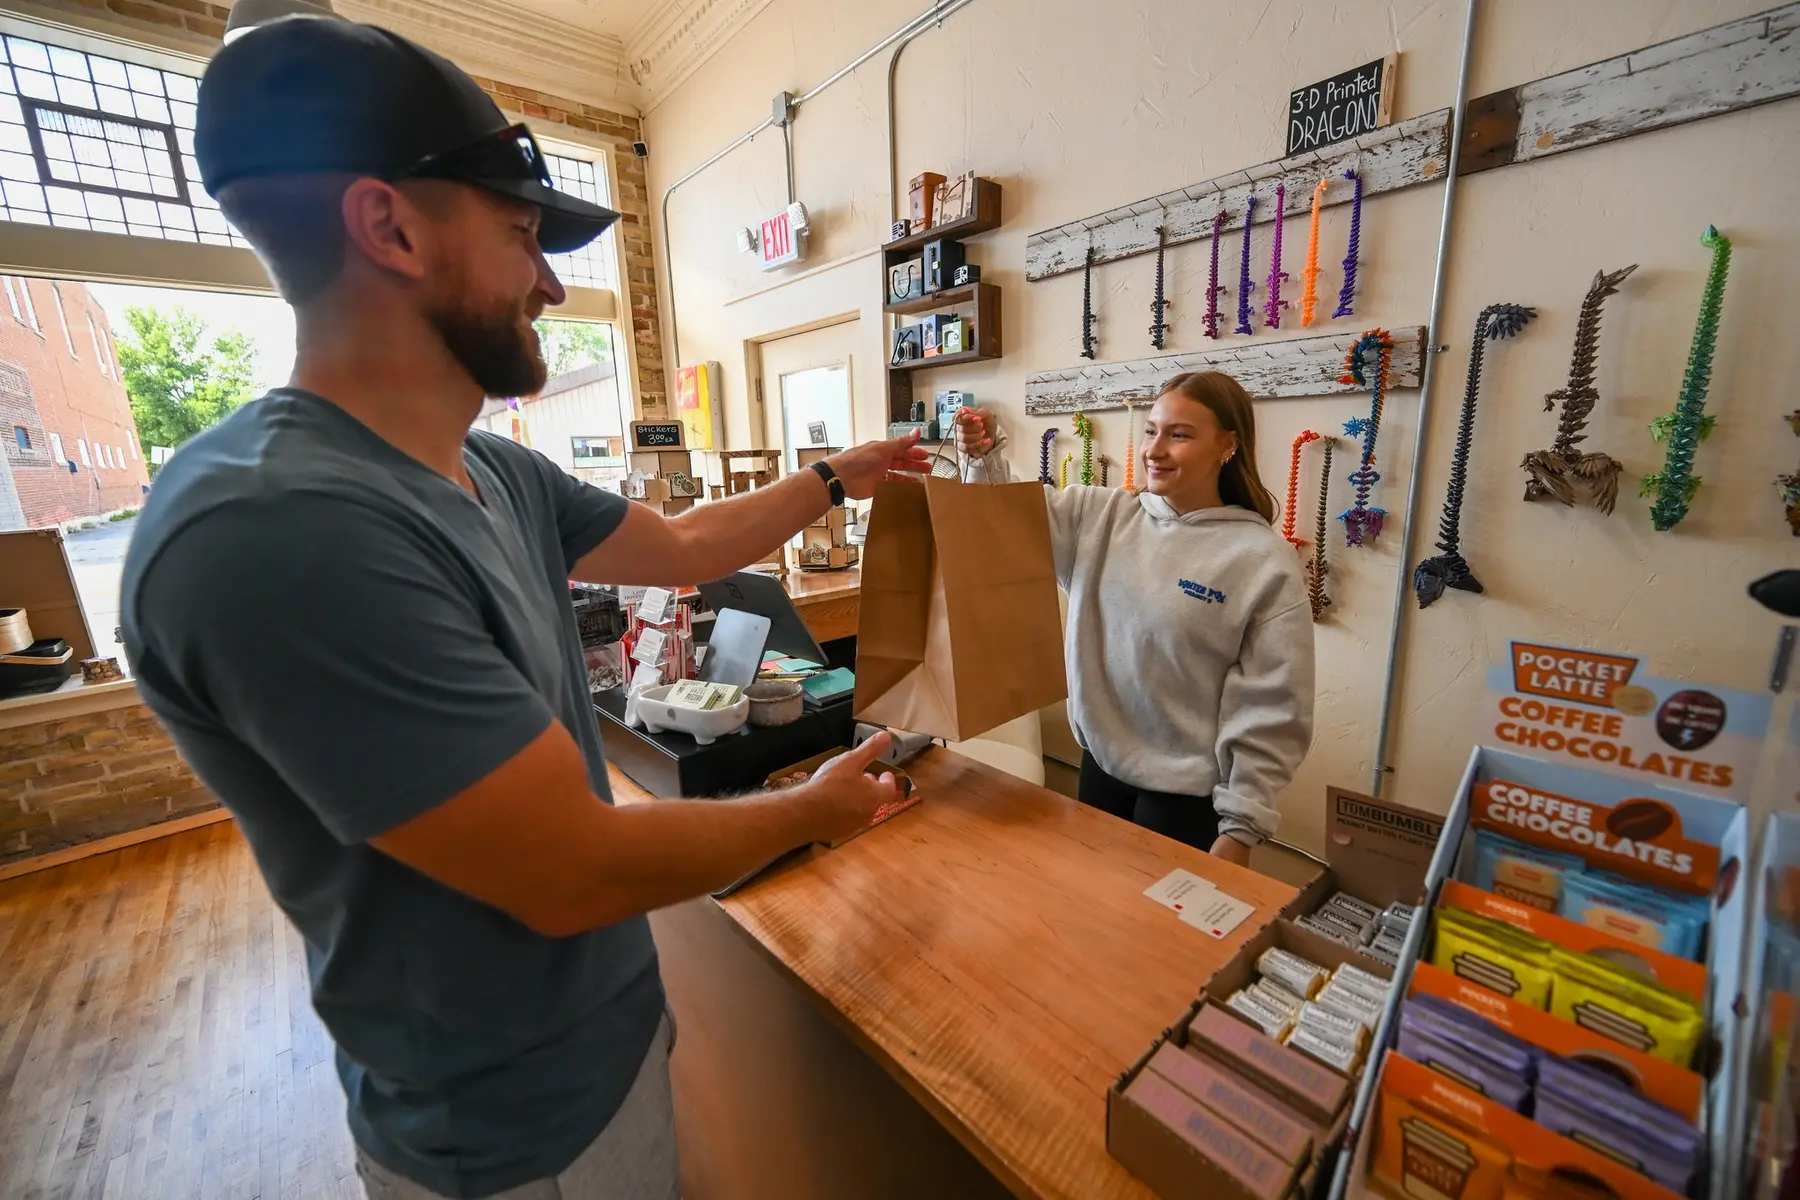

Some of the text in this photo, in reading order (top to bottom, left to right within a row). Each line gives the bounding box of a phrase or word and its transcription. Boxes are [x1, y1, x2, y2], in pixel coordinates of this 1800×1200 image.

[1291, 66, 1377, 114] 3-D Printed
[1289, 91, 1380, 152] DRAGONS
[761, 211, 791, 262] EXIT
[1518, 651, 1628, 681] POCKET
[1529, 671, 1608, 698] LATTE
[1499, 696, 1624, 738] COFFEE
[1495, 722, 1734, 788] CHOCOLATES
[1488, 784, 1593, 826] COFFEE
[1487, 803, 1694, 875] CHOCOLATES
